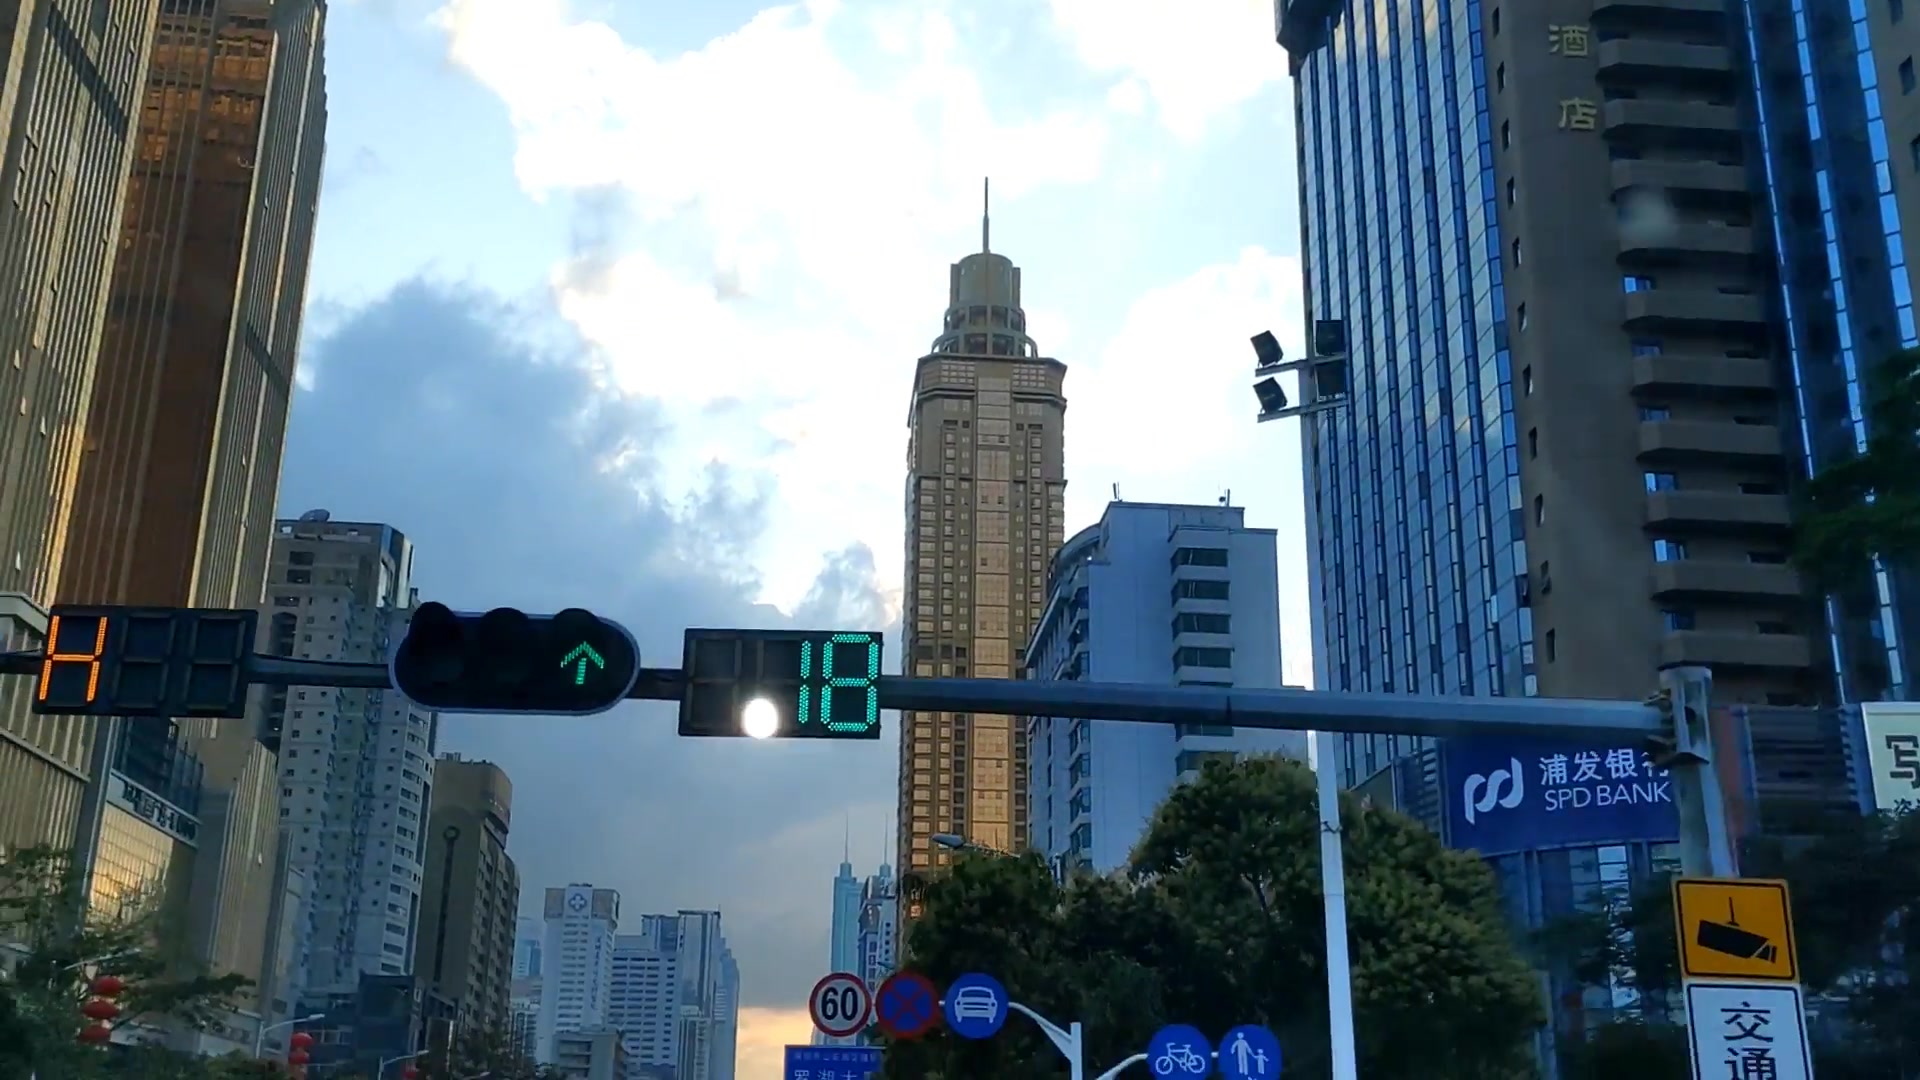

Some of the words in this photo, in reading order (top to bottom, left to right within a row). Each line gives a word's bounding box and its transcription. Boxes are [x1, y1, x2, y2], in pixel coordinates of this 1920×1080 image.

[1548, 24, 1597, 130] 酒店
[798, 634, 879, 732] 18
[1544, 787, 1592, 811] SPD
[1597, 781, 1671, 806] BANK
[821, 986, 859, 1021] 60
[1720, 1001, 1777, 1080] 交通
